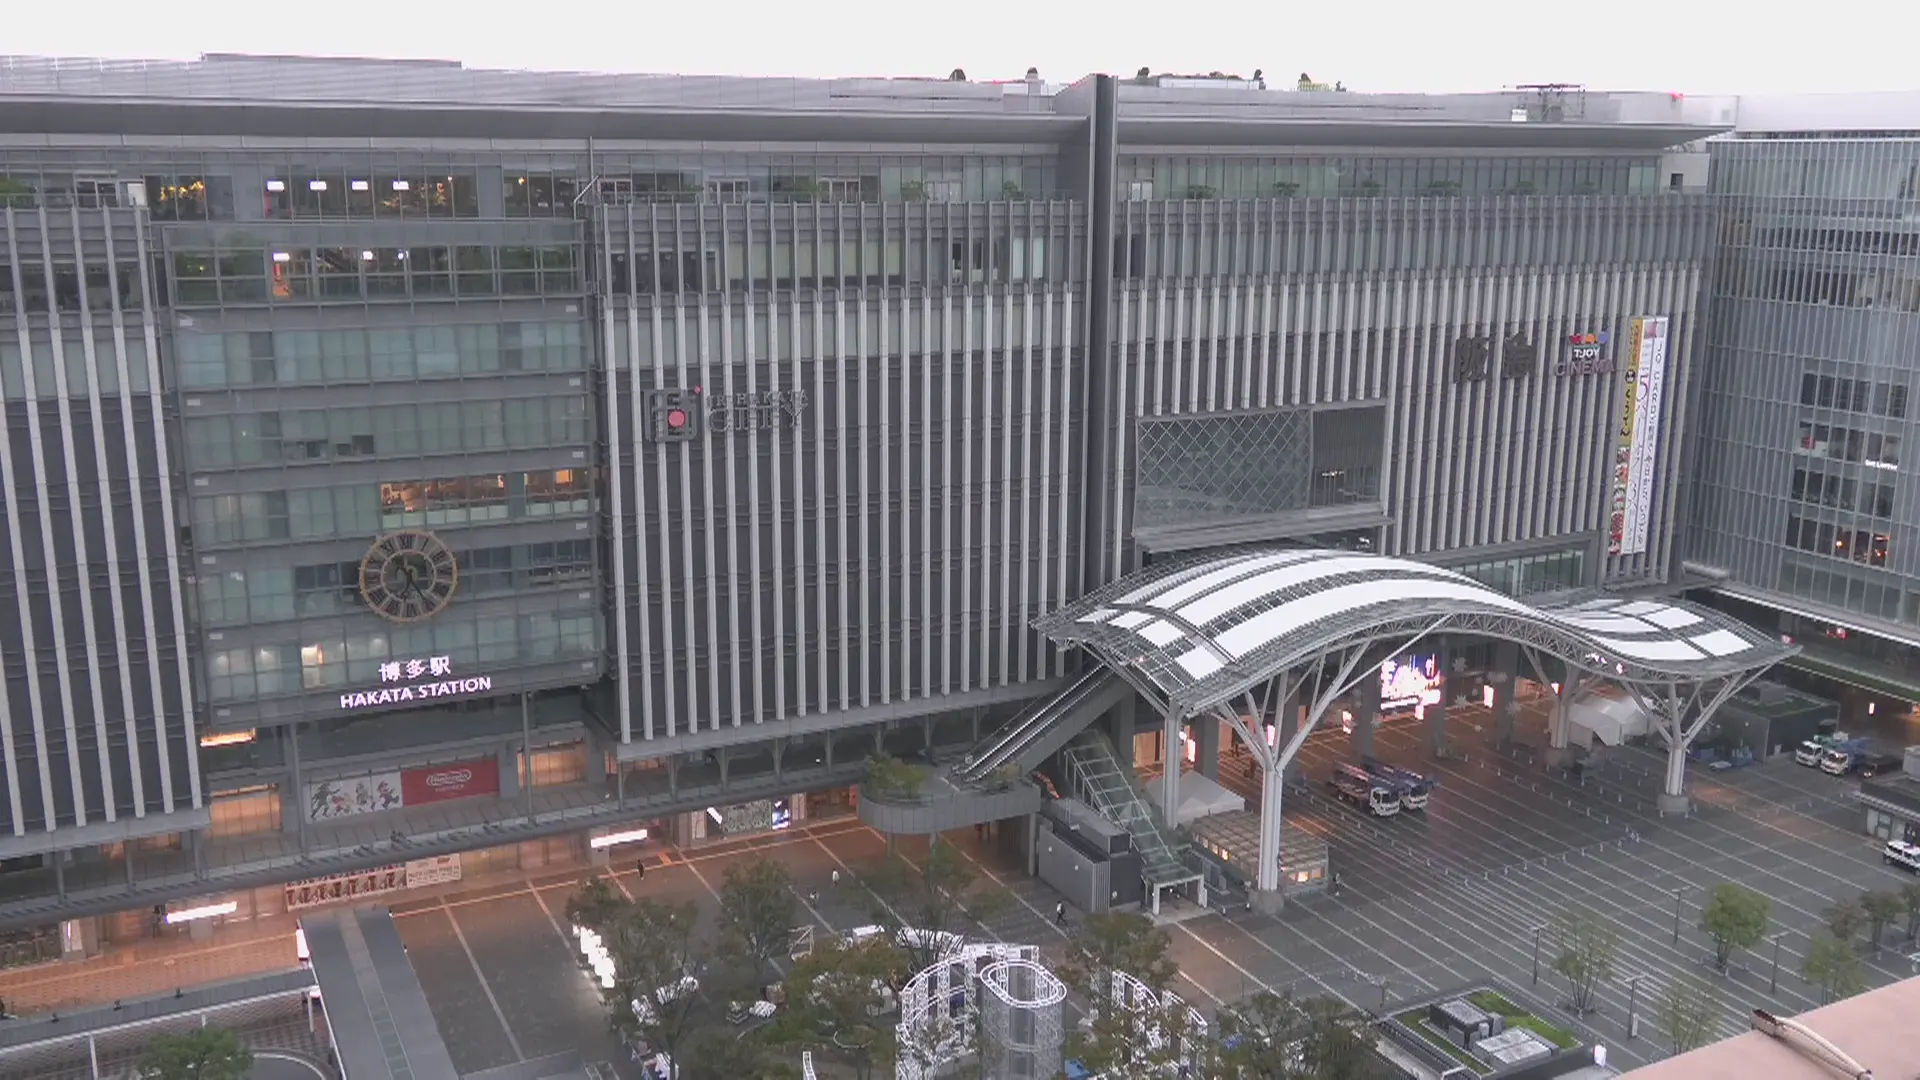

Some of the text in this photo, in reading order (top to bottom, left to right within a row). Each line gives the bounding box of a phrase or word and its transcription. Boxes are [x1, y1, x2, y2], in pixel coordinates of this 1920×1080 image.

[1554, 359, 1615, 376] CINEMA
[708, 402, 809, 432] CITY
[378, 655, 451, 683] 博多駅
[340, 676, 492, 709] HAKATA STATION
